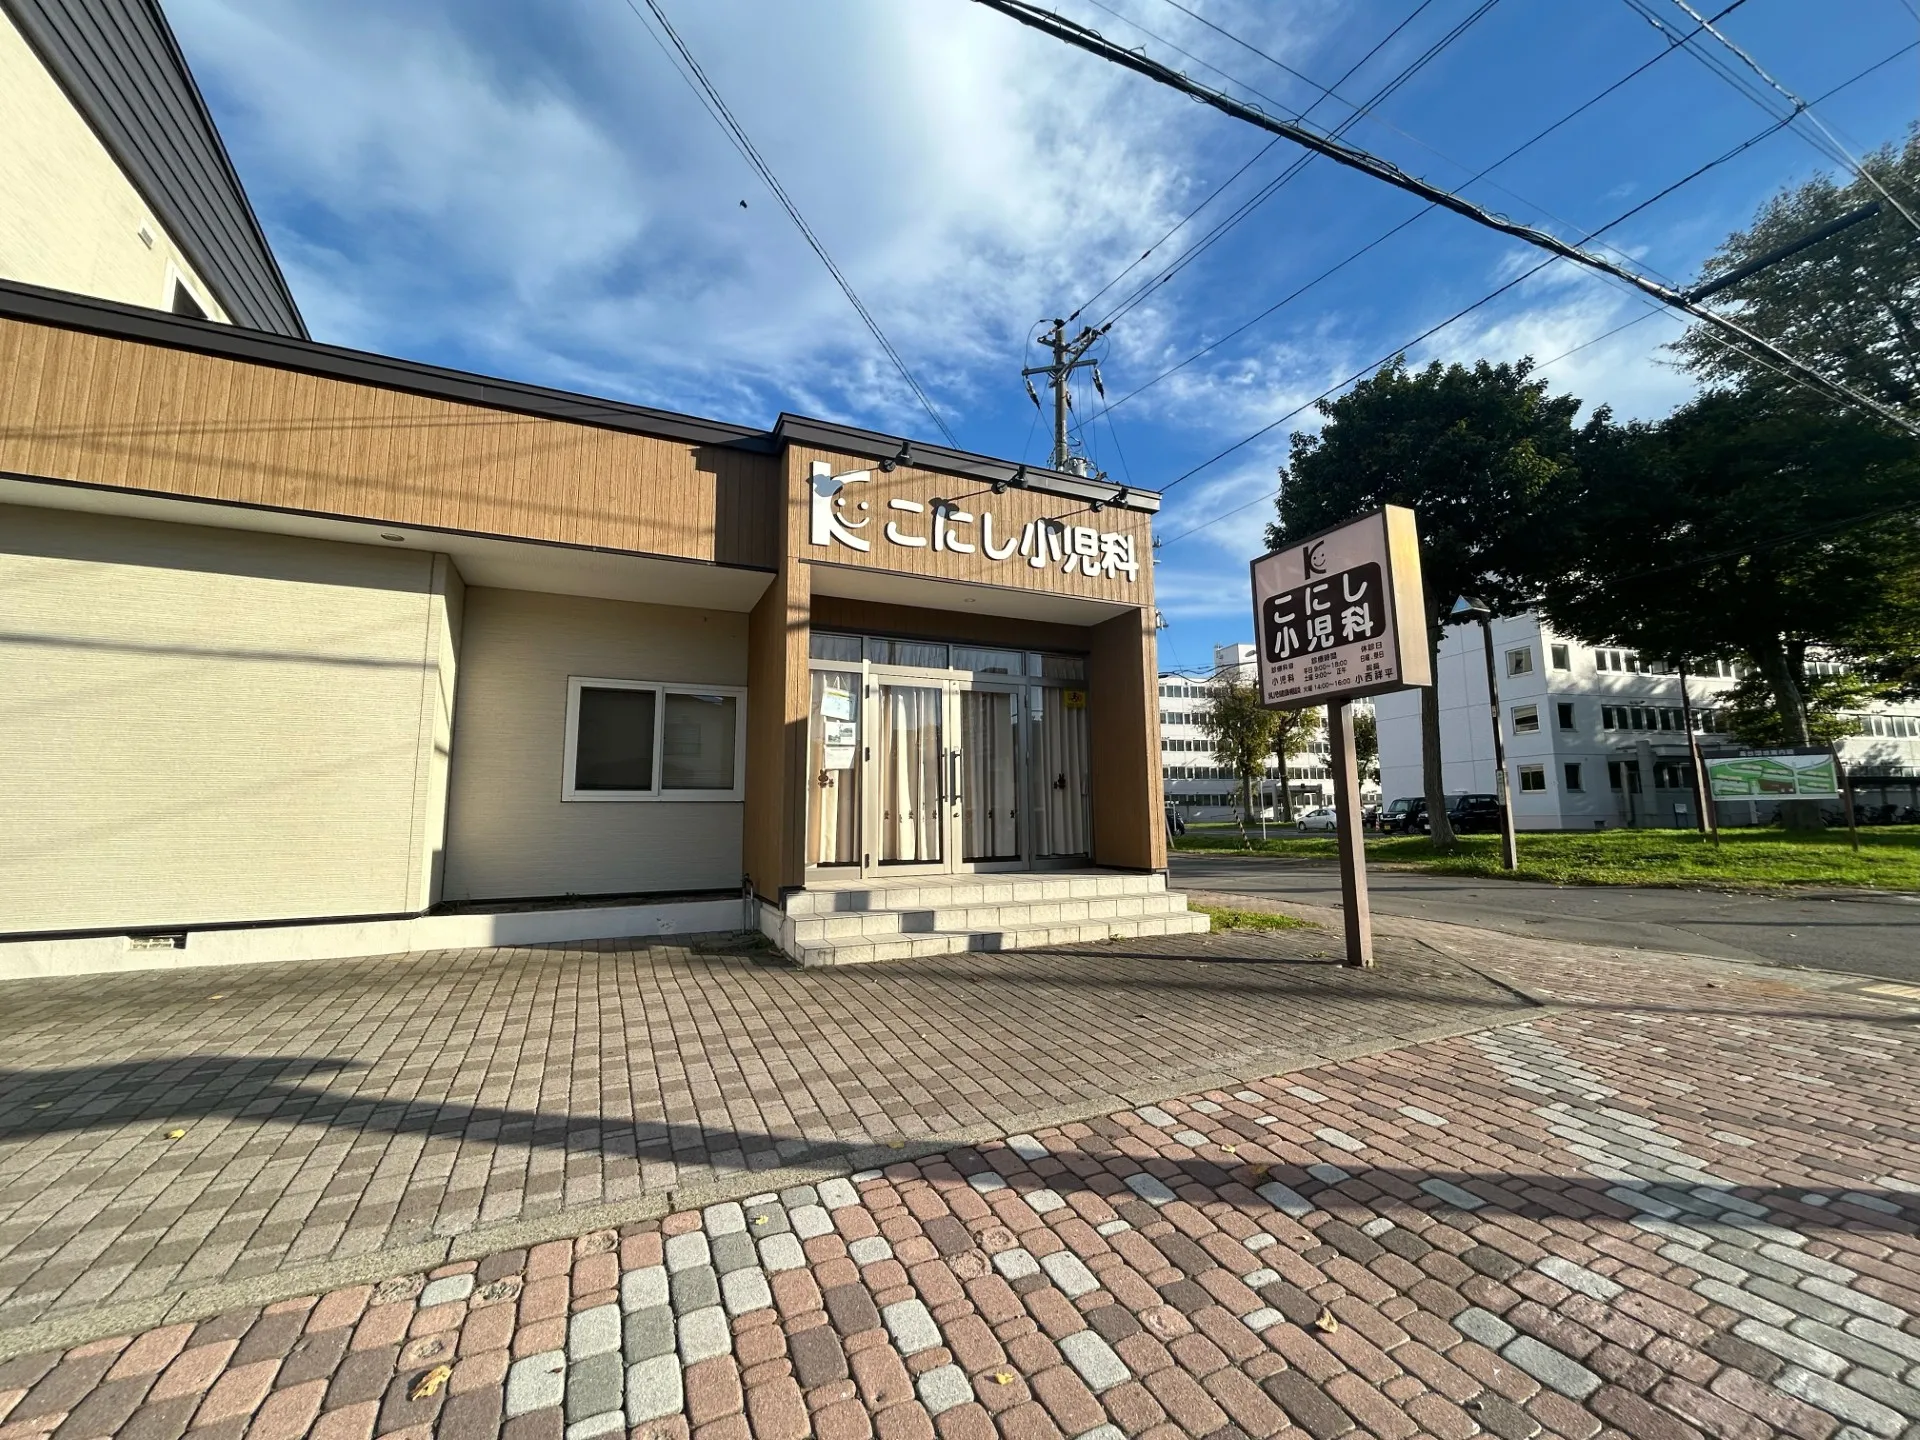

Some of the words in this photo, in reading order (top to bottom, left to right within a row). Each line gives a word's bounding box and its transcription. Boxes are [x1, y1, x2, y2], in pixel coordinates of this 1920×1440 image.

[885, 497, 1140, 582] こにし小児科
[1273, 573, 1368, 624] こにし
[1274, 602, 1374, 658] 小児科
[1361, 641, 1383, 653] 休診日
[1311, 652, 1337, 665] 診療時間
[1303, 665, 1313, 674] 平日
[1354, 667, 1394, 685] 小西祥平
[1271, 673, 1295, 686] 小児科
